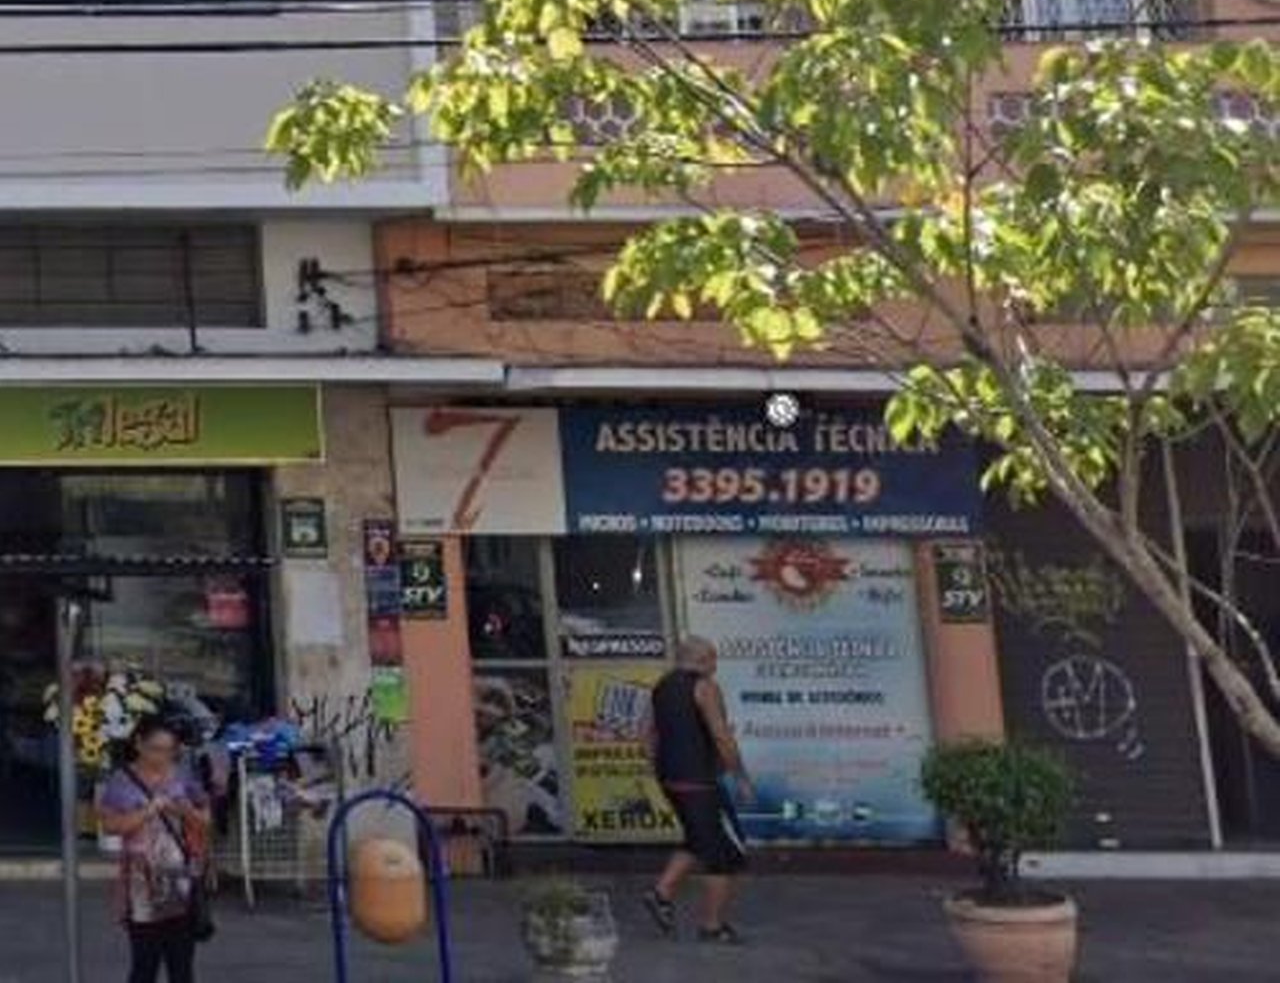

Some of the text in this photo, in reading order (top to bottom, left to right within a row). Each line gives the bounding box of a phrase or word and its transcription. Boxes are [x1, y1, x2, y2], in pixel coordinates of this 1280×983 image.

[814, 415, 939, 452] TÉCNA
[663, 468, 881, 503] 3395.1919
[941, 588, 984, 608] STV
[585, 810, 676, 830] XEROX
